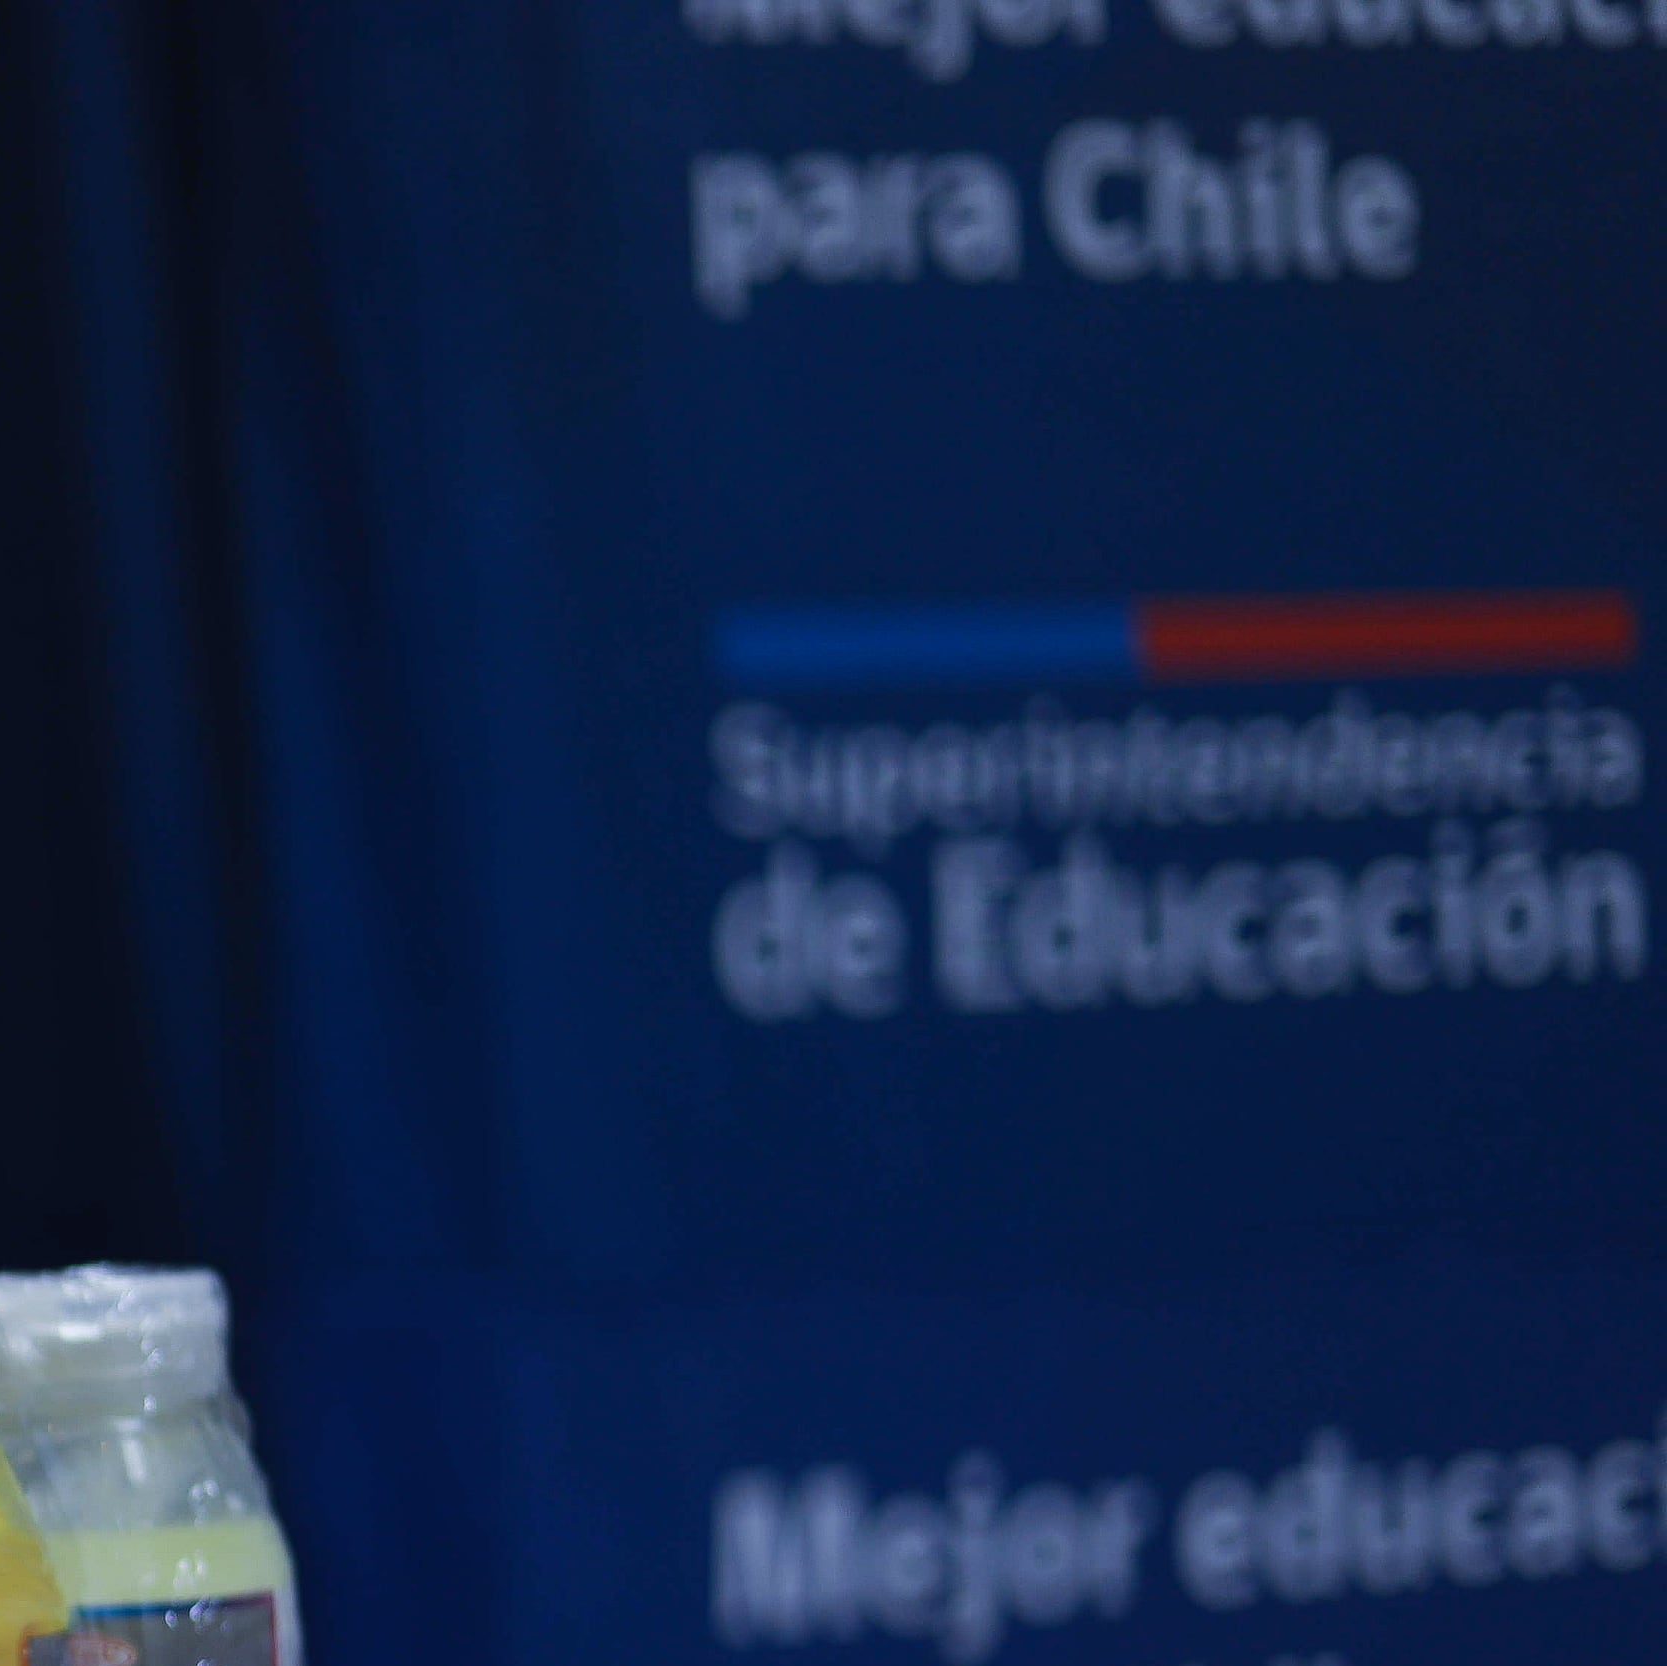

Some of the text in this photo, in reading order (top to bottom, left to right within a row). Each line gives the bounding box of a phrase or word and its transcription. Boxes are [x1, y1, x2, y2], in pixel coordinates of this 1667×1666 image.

[689, 115, 1419, 320] para Chile
[709, 680, 1644, 860] Superintendencia
[711, 817, 1649, 1024] de Educación
[1175, 1424, 1667, 1612] educac
